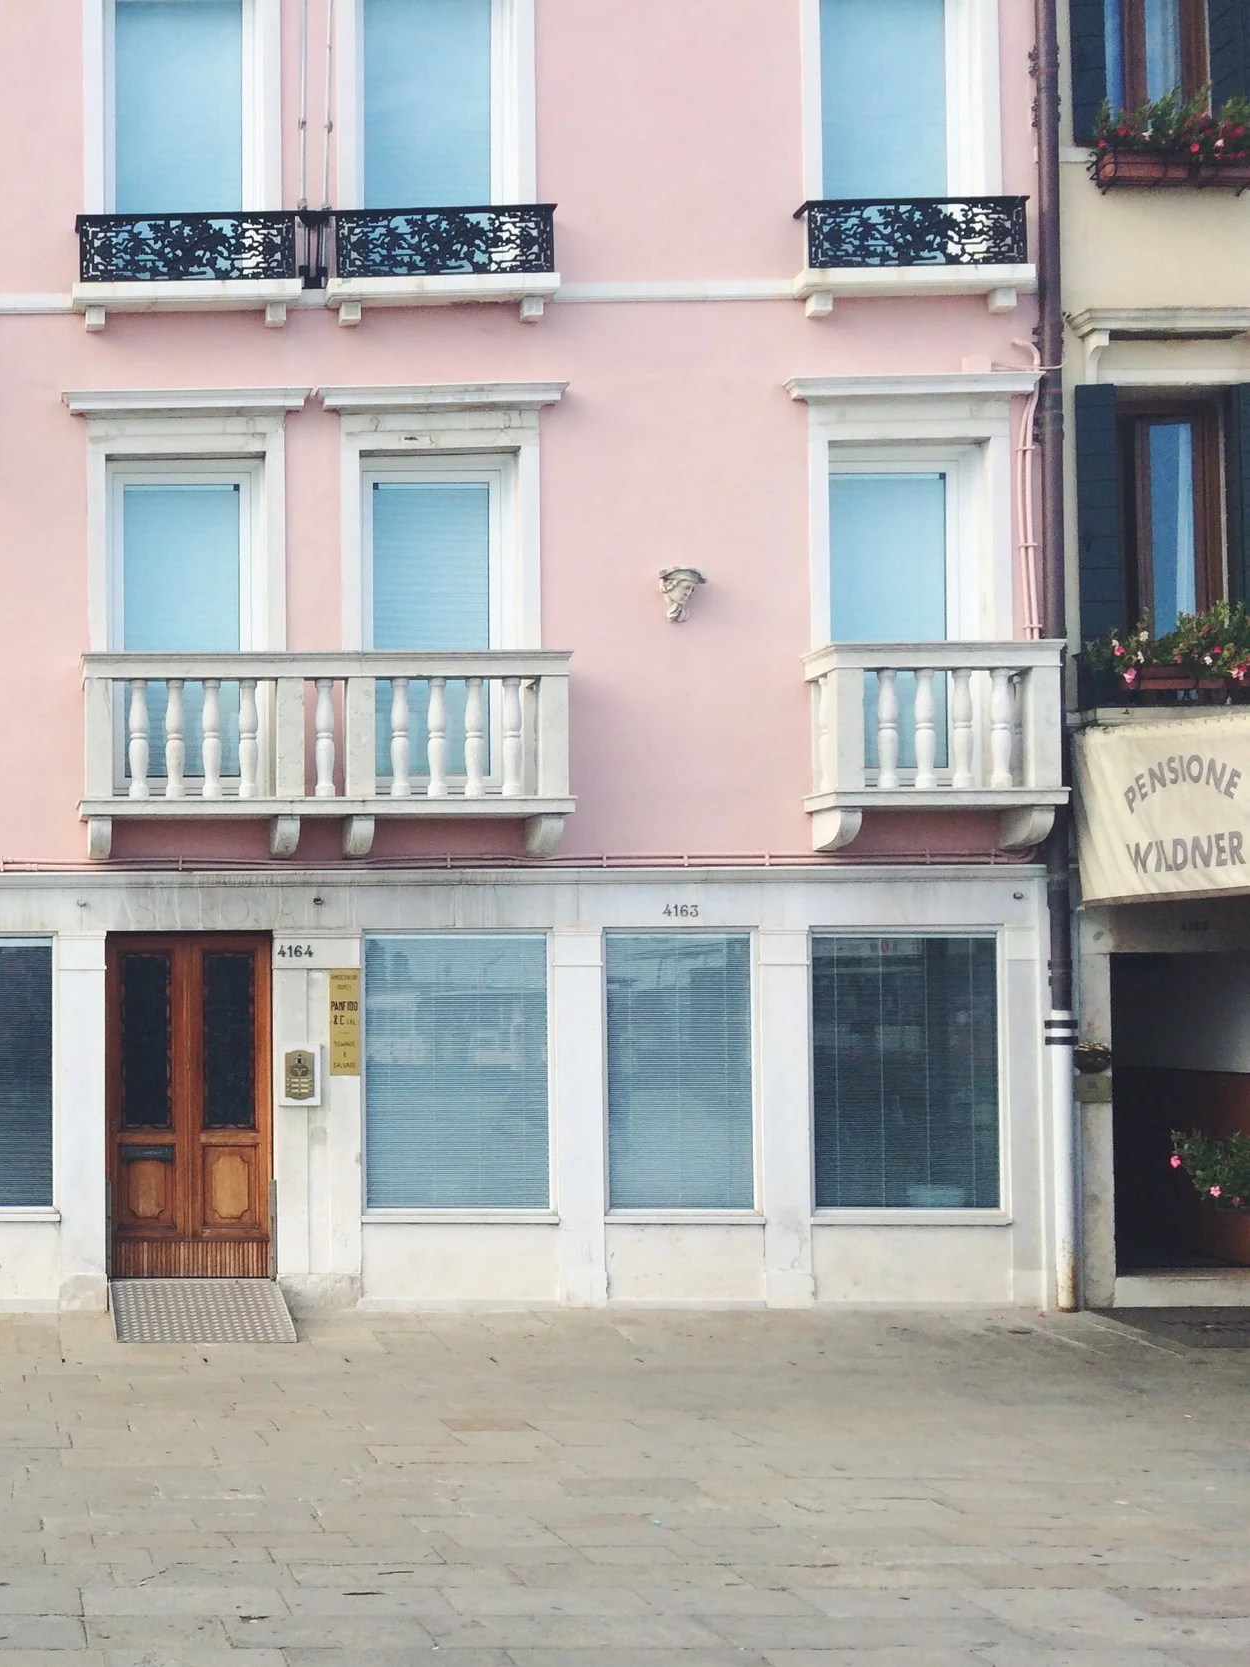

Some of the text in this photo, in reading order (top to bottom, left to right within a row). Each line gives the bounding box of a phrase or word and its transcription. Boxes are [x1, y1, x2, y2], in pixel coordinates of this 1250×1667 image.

[1124, 754, 1243, 815] PENSIONE
[1126, 830, 1247, 874] WILDNER
[662, 903, 699, 918] 4163
[277, 944, 314, 958] 4164
[333, 1014, 338, 1025] &
